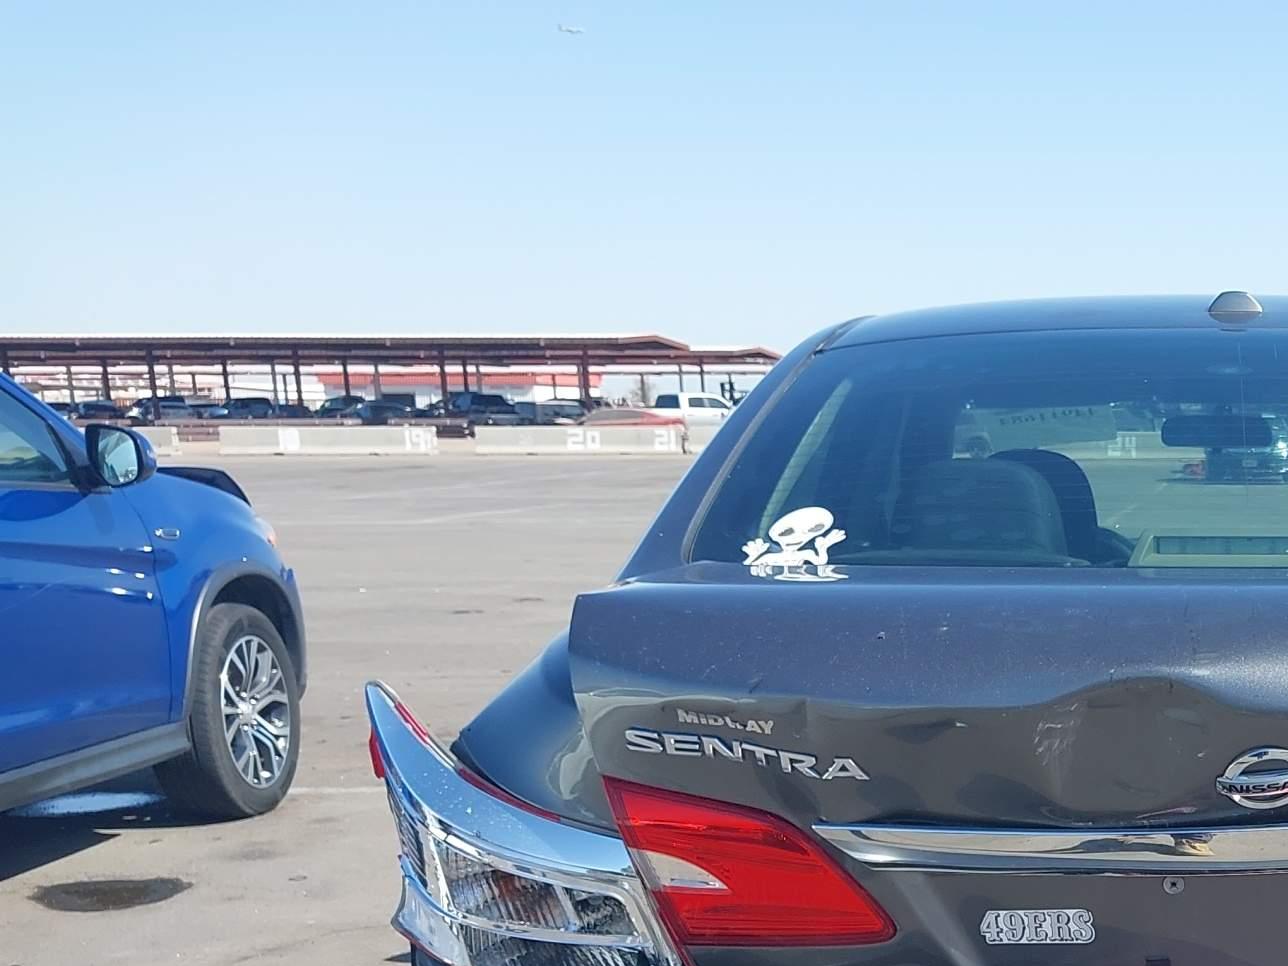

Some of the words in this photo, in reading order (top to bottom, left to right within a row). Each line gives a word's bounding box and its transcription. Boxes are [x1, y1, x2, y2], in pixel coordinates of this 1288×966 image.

[566, 429, 601, 451] 20
[653, 429, 677, 451] 21
[624, 728, 871, 781] SENTRA
[981, 910, 1095, 943] 49ERS
